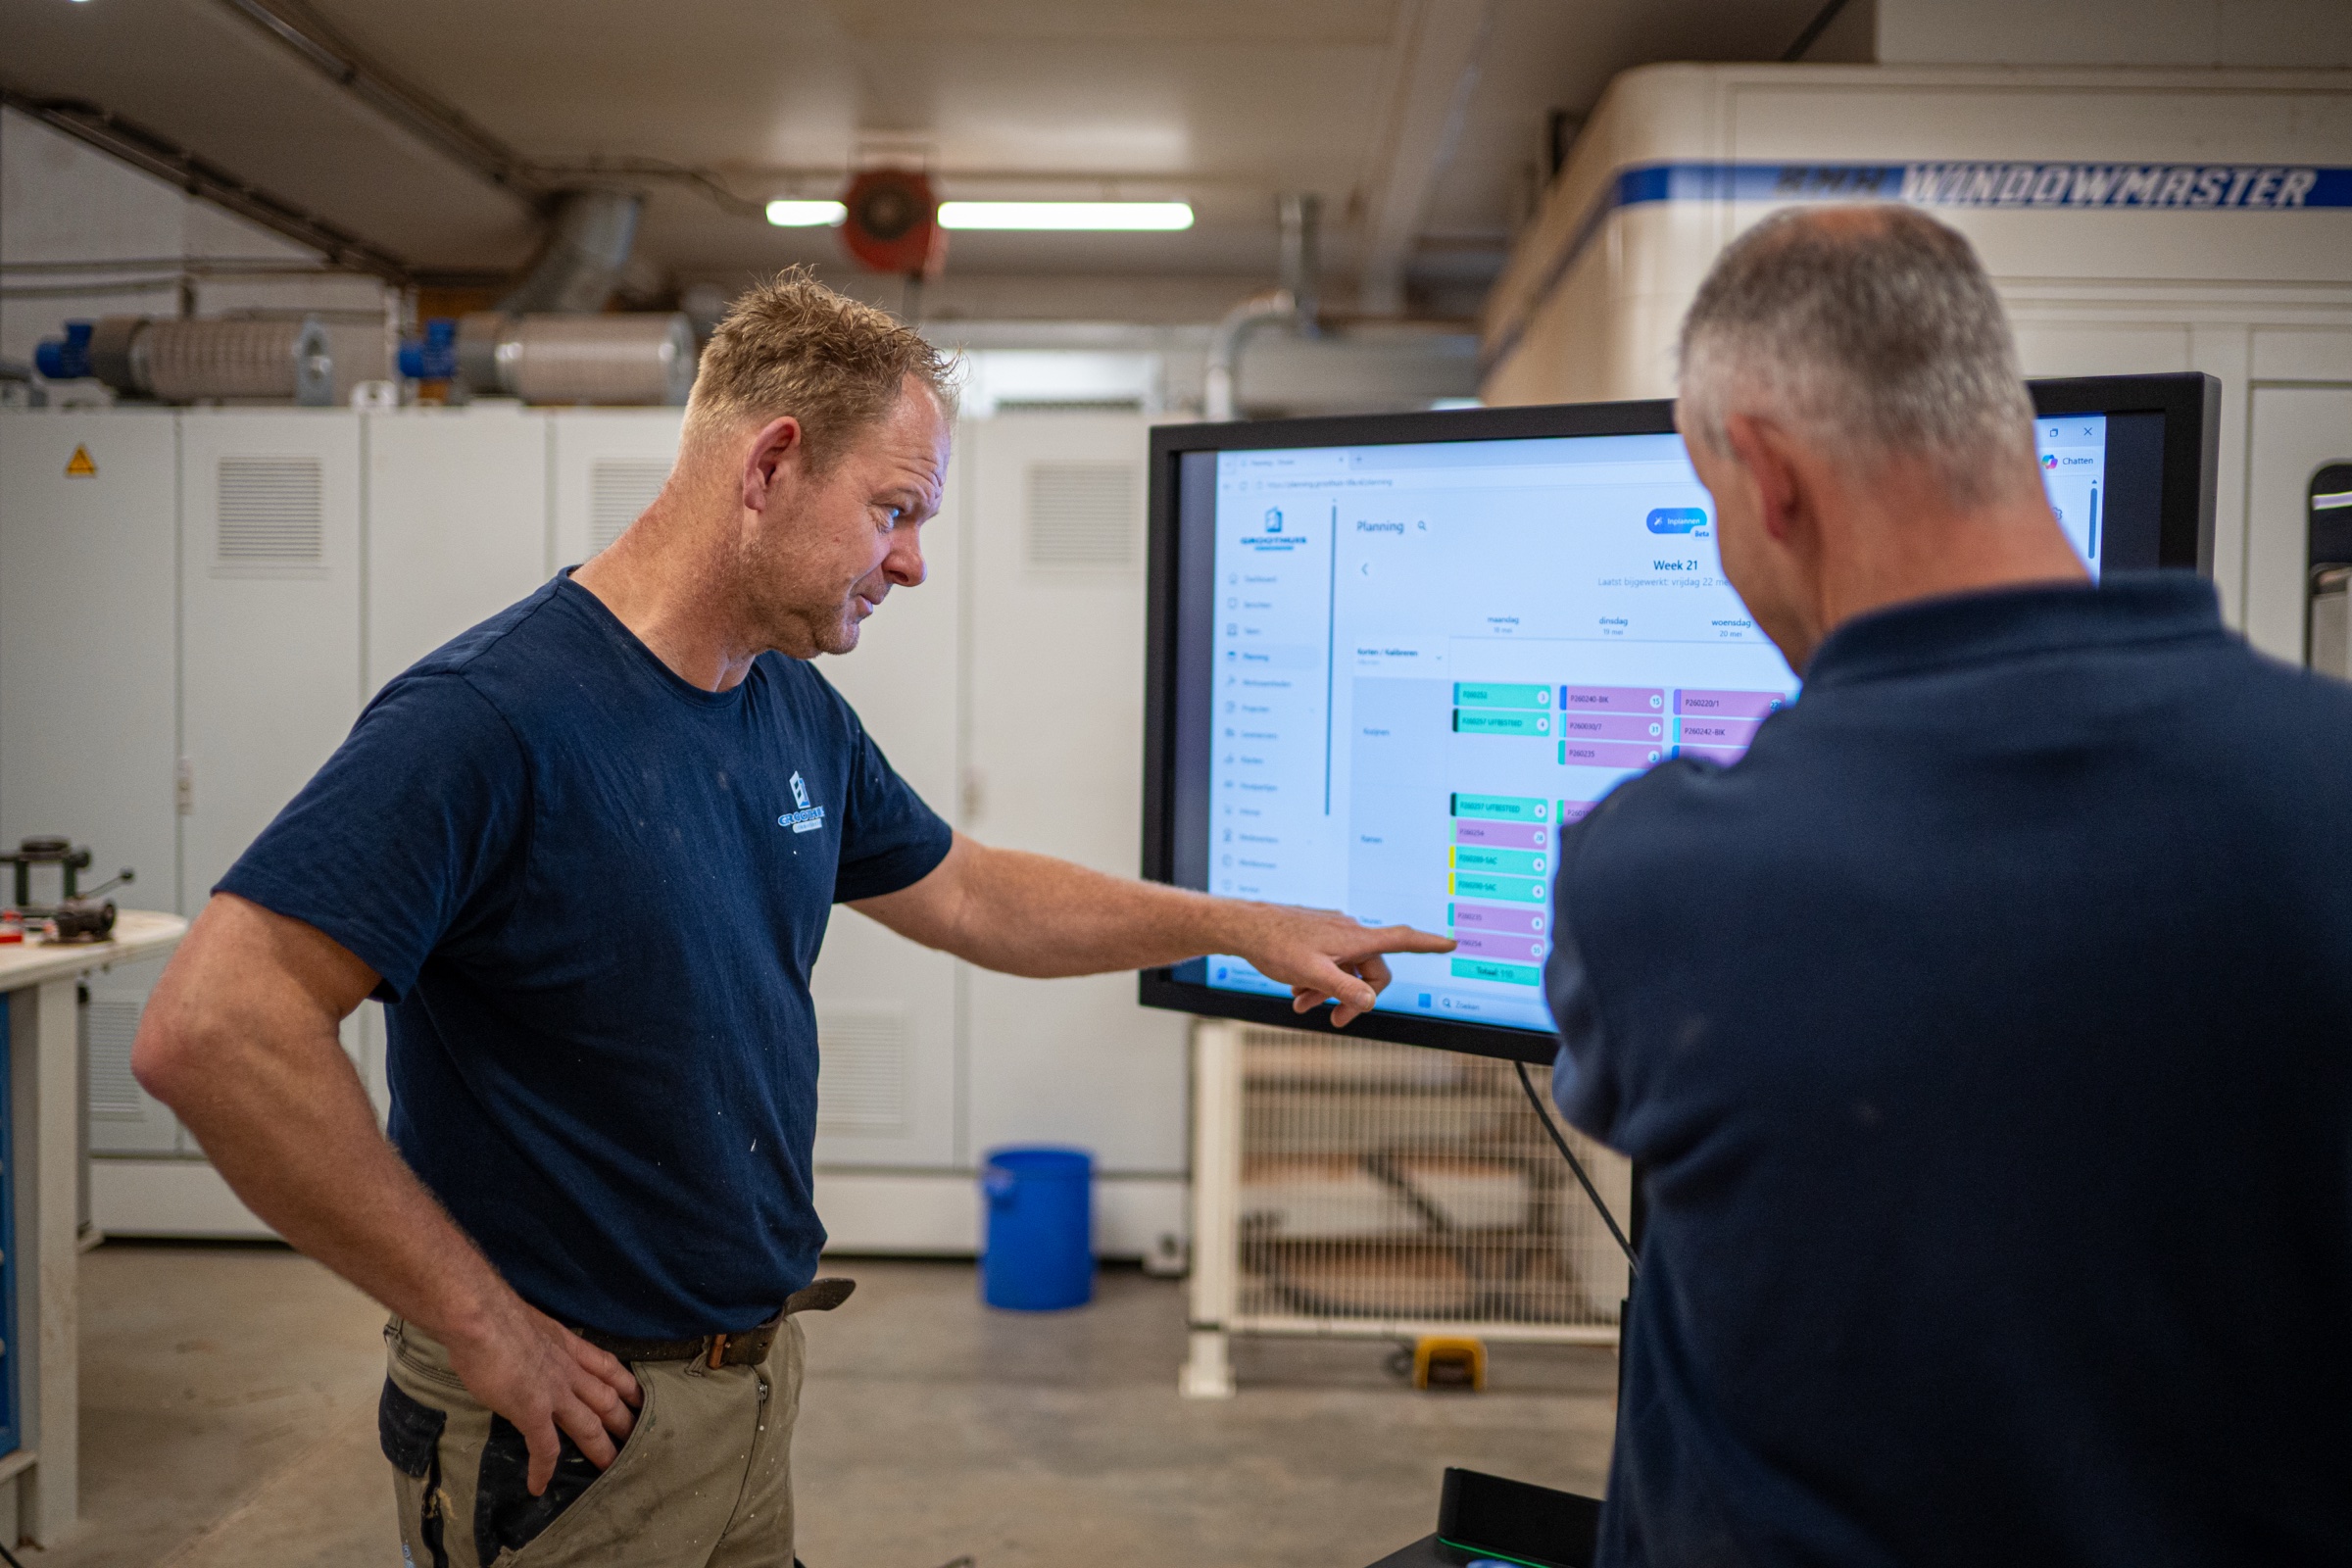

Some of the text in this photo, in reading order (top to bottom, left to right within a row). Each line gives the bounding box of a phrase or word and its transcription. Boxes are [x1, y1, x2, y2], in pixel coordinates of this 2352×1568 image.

[1899, 163, 2317, 207] WINDOWMASTER
[2062, 457, 2094, 466] Chatten
[1667, 516, 1700, 526] Inplannen
[1356, 521, 1404, 534] Planning
[1653, 560, 1698, 570] Week 21
[1597, 577, 1622, 586] Laatst
[1624, 577, 1668, 588] bijgewerkt:
[1671, 577, 1700, 588] vrijdag
[1702, 577, 1713, 586] 22
[1487, 615, 1519, 624] maandag
[1598, 616, 1629, 626] dinsdag
[1711, 618, 1751, 628] woensdag
[1652, 697, 1660, 706] 15
[1685, 699, 1719, 708] P260220/1
